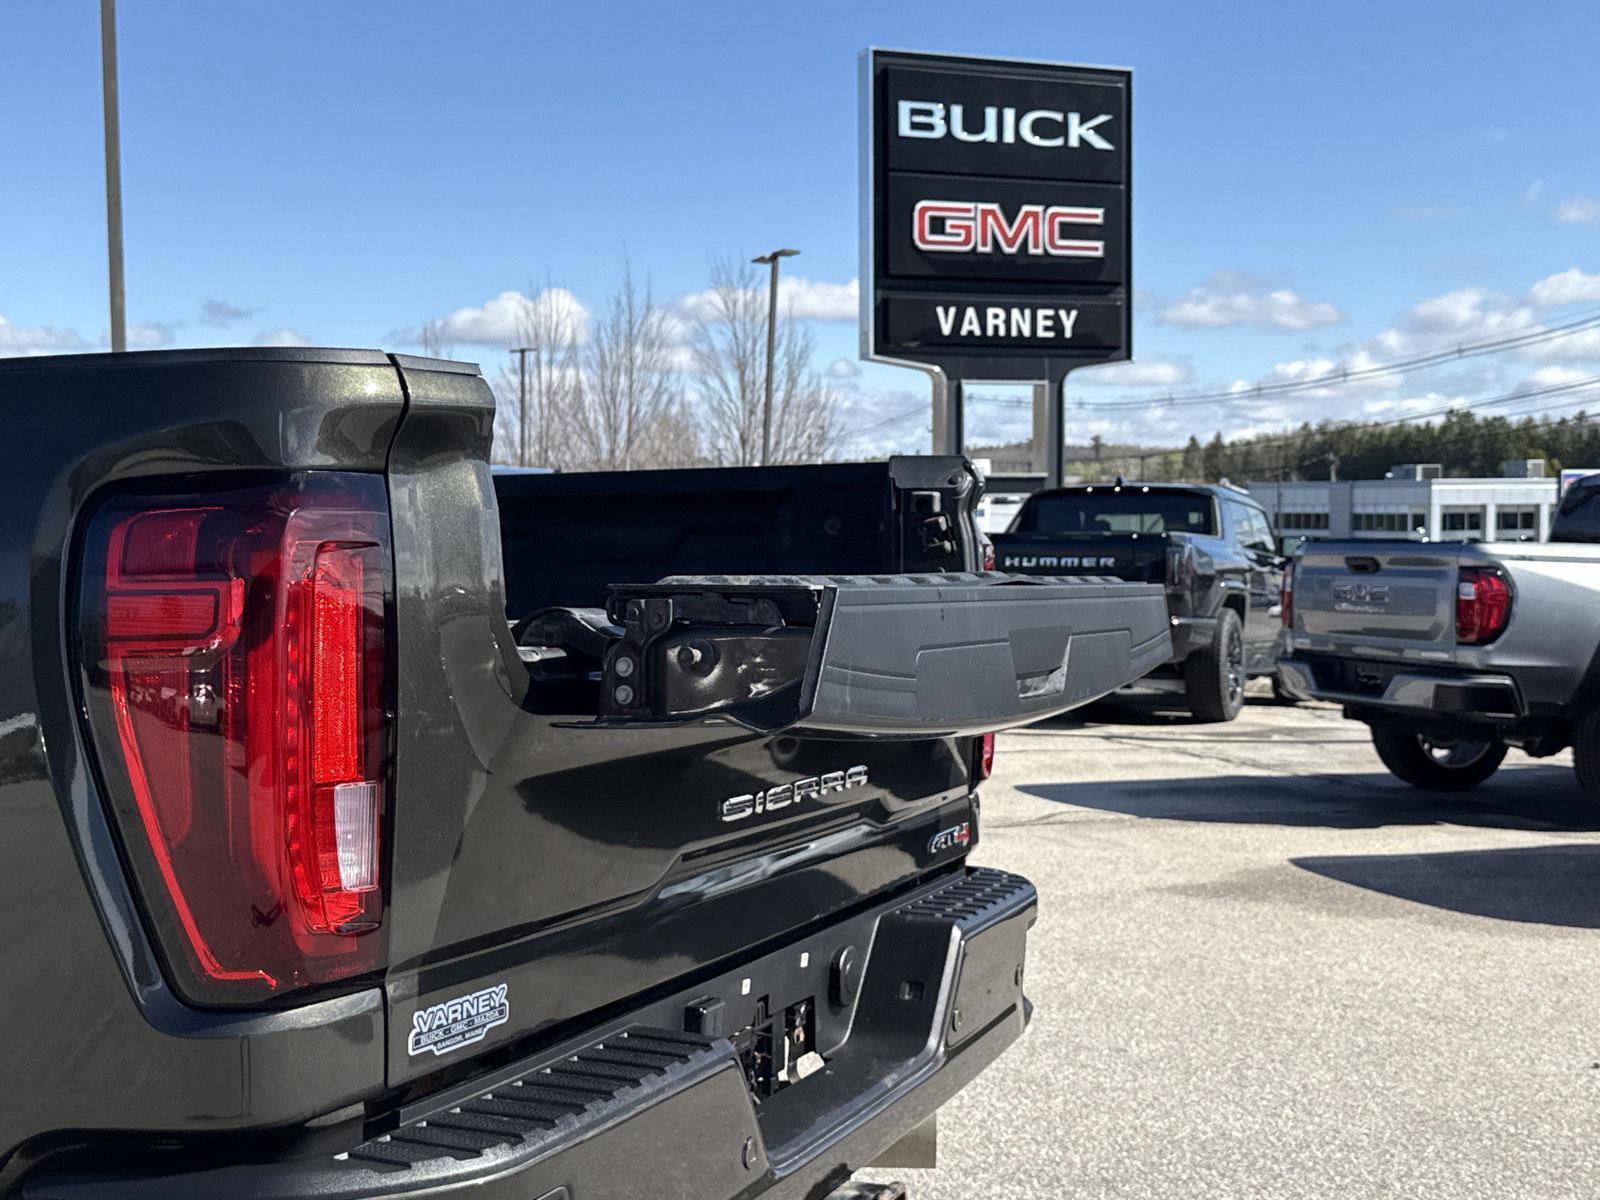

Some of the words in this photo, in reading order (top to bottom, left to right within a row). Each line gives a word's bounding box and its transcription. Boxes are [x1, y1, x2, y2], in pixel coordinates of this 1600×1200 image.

[898, 100, 1115, 151] BUICK
[913, 199, 1105, 258] GMC
[935, 305, 1079, 339] VARNEY
[1004, 556, 1116, 568] HUMMER
[1332, 583, 1390, 603] GMC
[721, 764, 869, 822] SIERRA
[417, 987, 505, 1033] VARNEY
[420, 1029, 445, 1045] BUICK
[450, 1020, 469, 1034] GMC
[474, 1009, 501, 1025] MAZDA
[465, 1026, 484, 1040] MAINE
